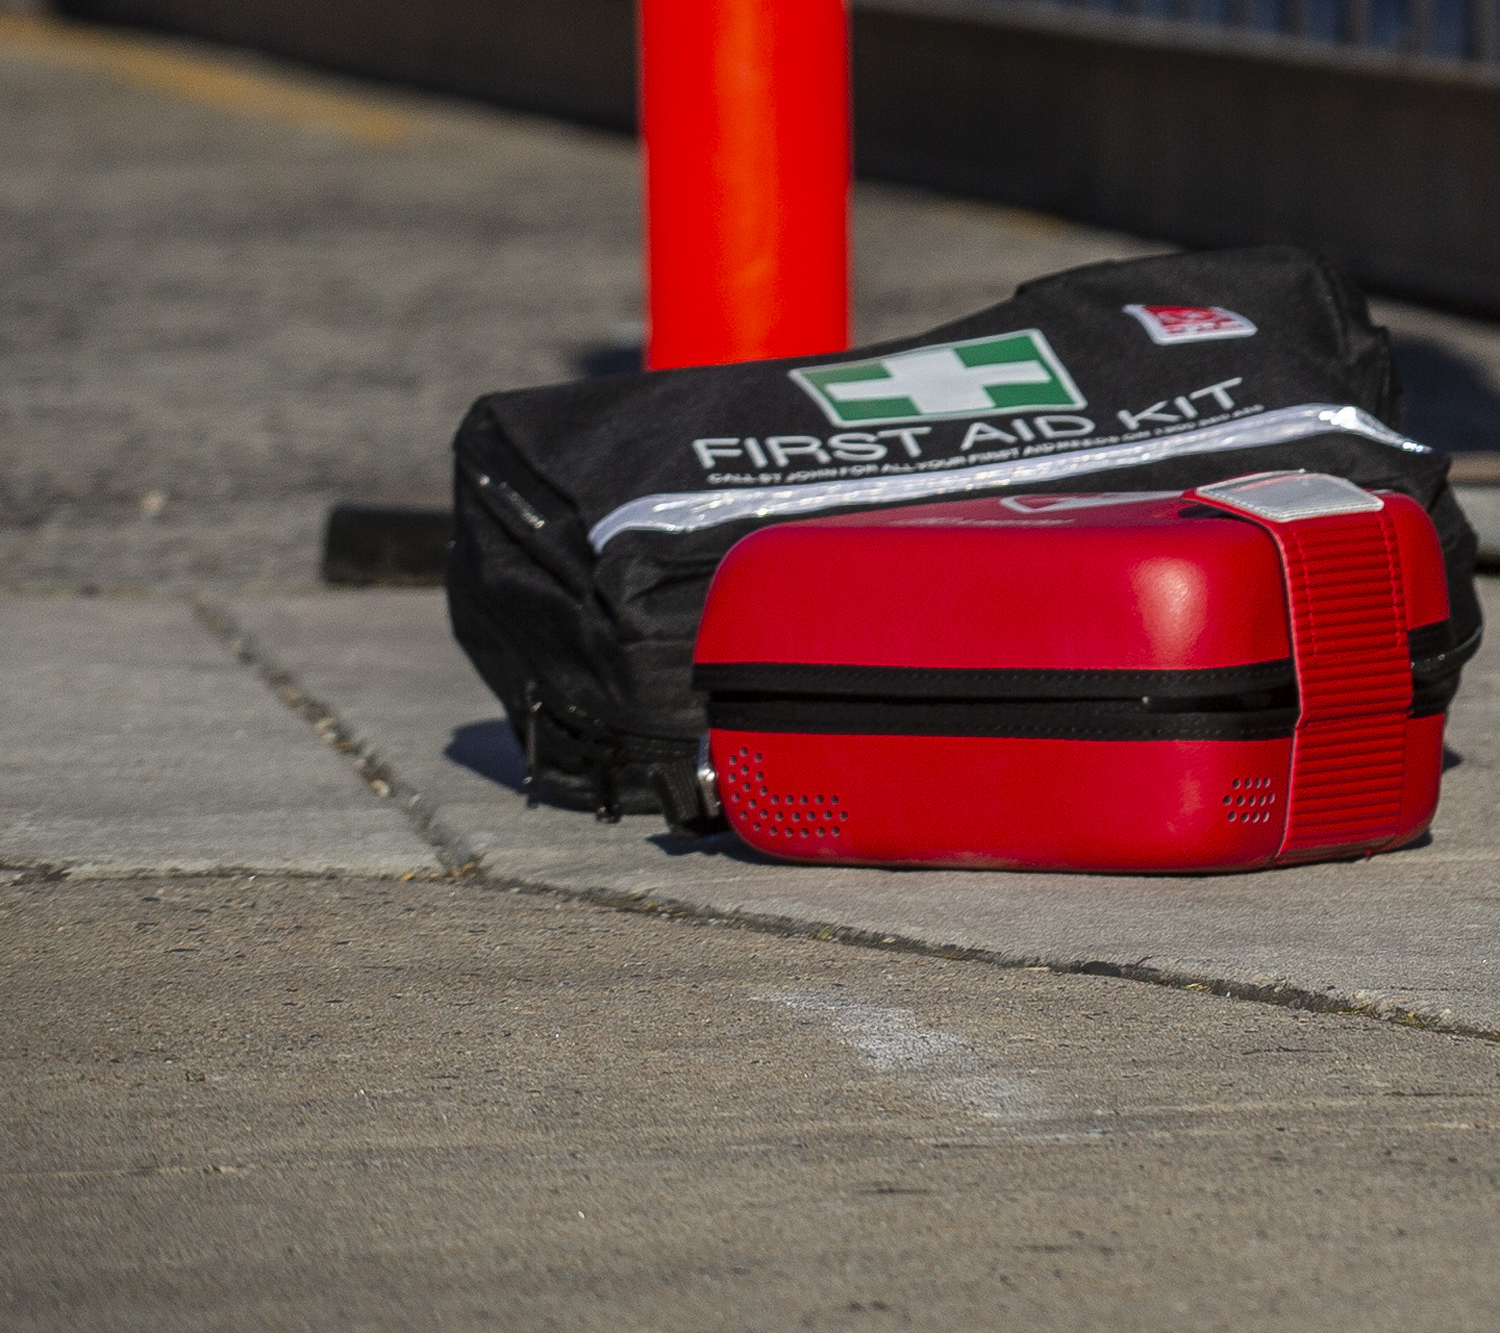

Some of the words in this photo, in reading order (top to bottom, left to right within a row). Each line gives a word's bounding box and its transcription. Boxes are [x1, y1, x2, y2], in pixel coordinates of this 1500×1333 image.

[691, 426, 933, 470] FIRST
[960, 414, 1096, 452] AID
[1116, 377, 1243, 431] KIT
